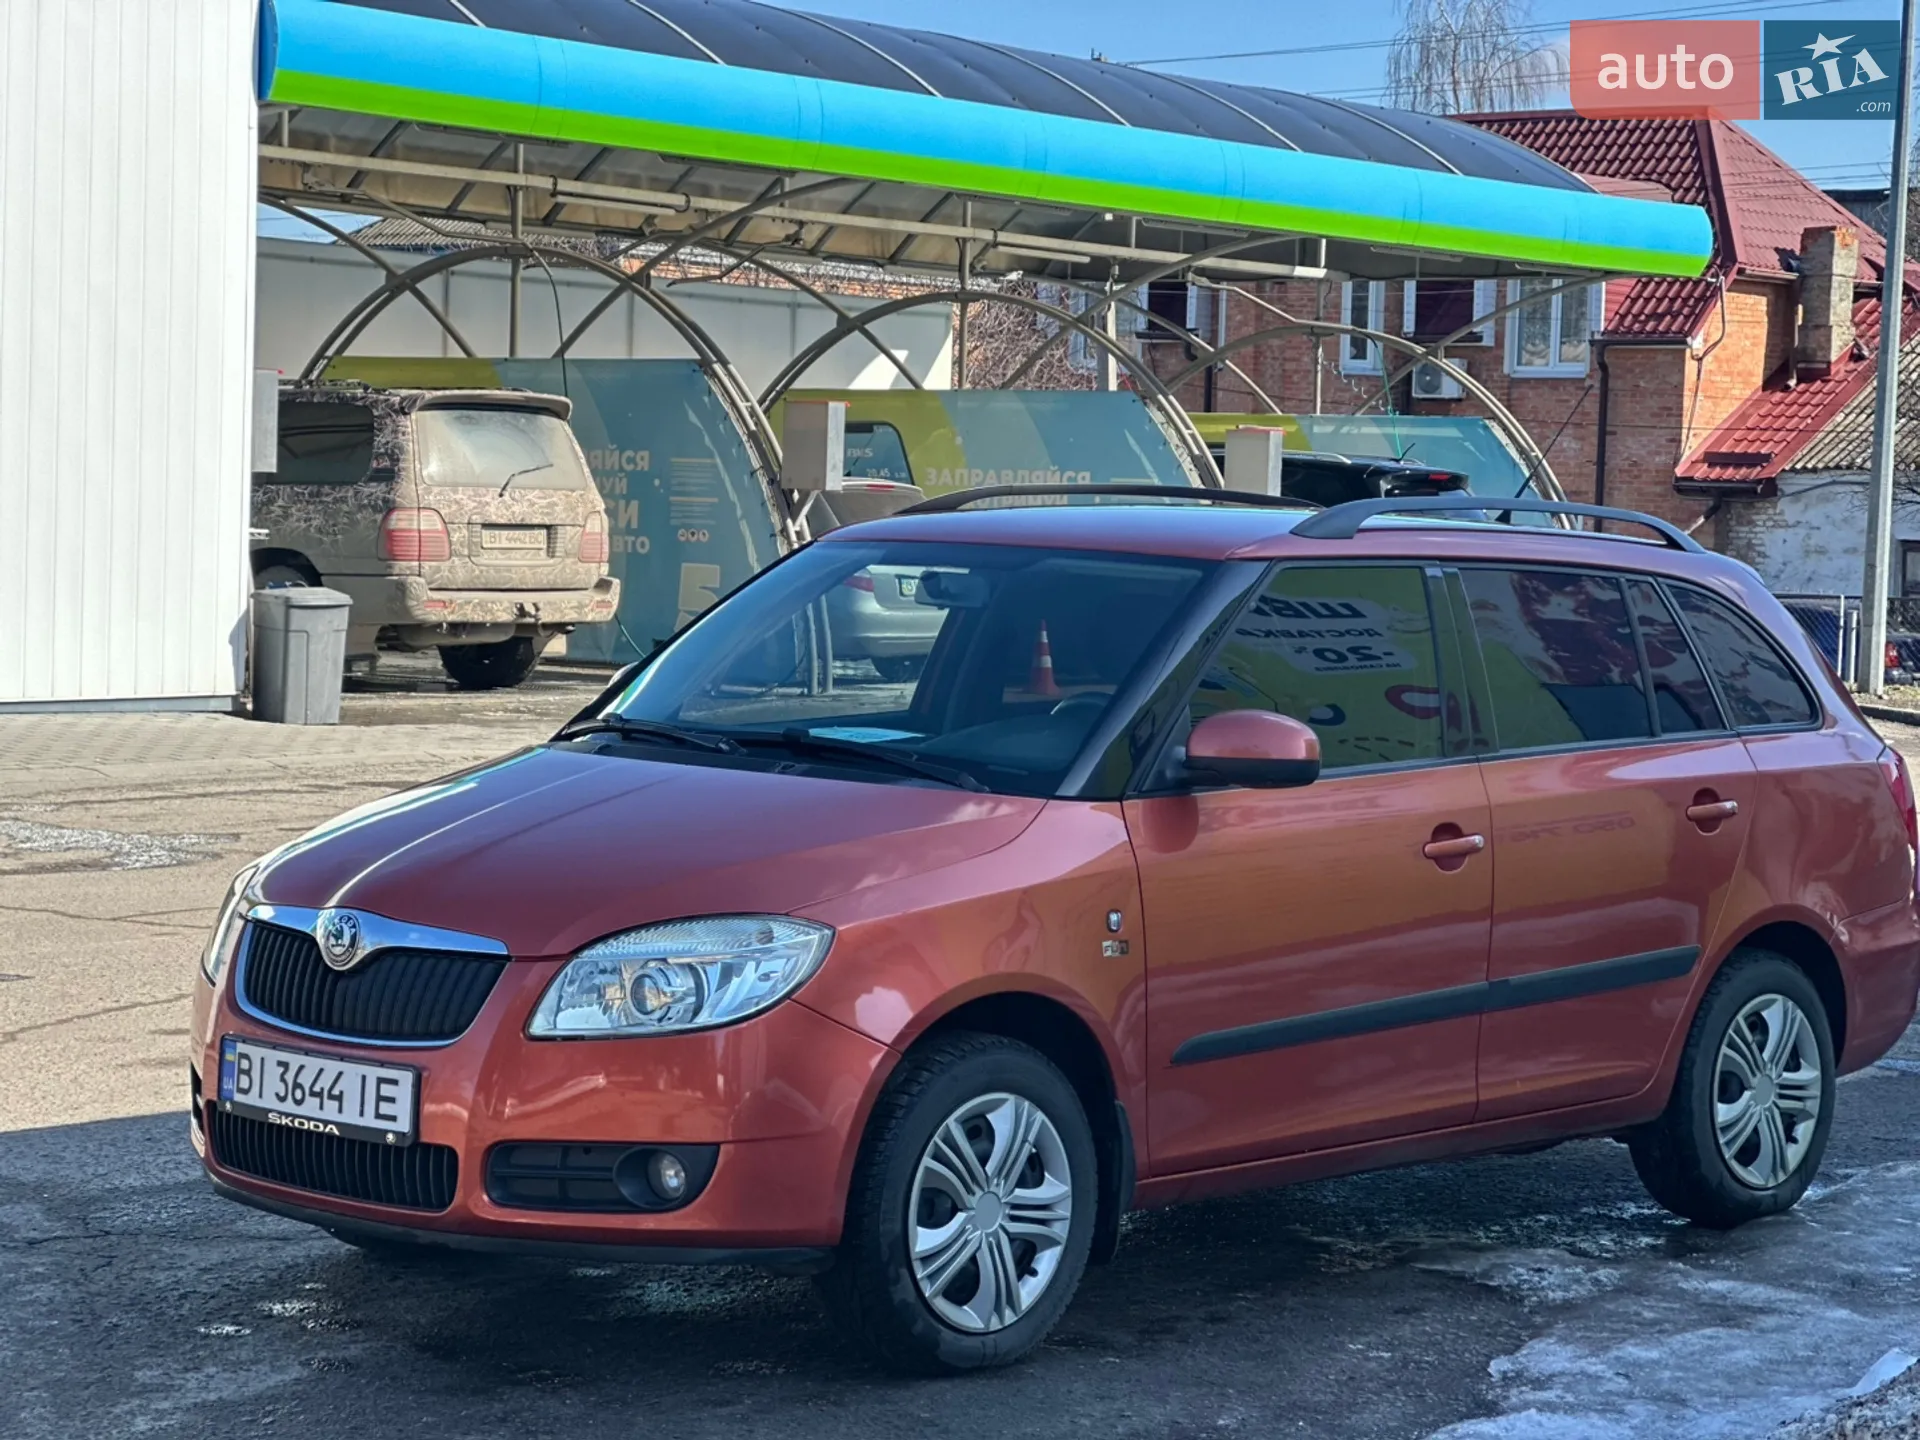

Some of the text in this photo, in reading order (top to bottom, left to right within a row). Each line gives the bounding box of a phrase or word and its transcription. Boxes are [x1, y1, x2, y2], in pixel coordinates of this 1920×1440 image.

[612, 535, 650, 555] ВТО
[275, 1060, 344, 1115] 3644
[359, 1074, 399, 1122] IE
[267, 1111, 340, 1136] SKODA
